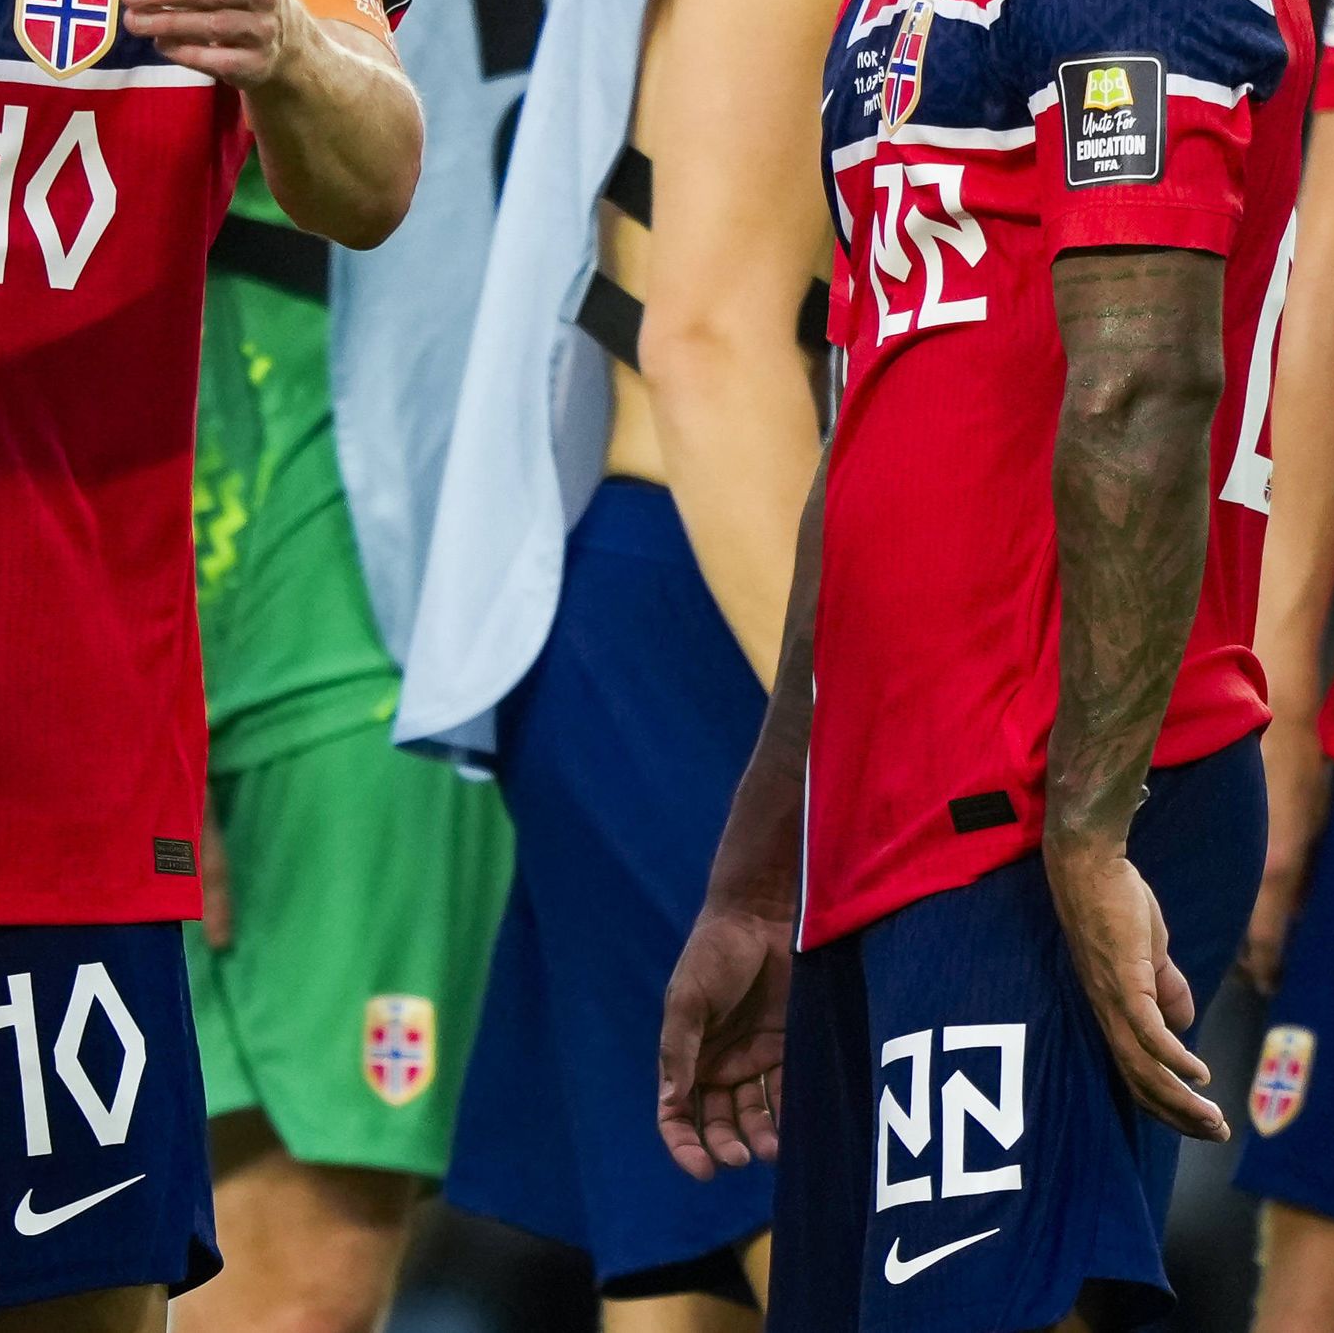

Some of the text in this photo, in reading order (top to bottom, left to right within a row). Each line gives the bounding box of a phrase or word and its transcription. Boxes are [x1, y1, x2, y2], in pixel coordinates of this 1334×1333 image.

[1082, 109, 1137, 138] Unite For
[1076, 134, 1147, 162] EDUCATION
[1094, 158, 1122, 173] FIFA
[869, 162, 987, 348] 22
[876, 1022, 1027, 1213] 22
